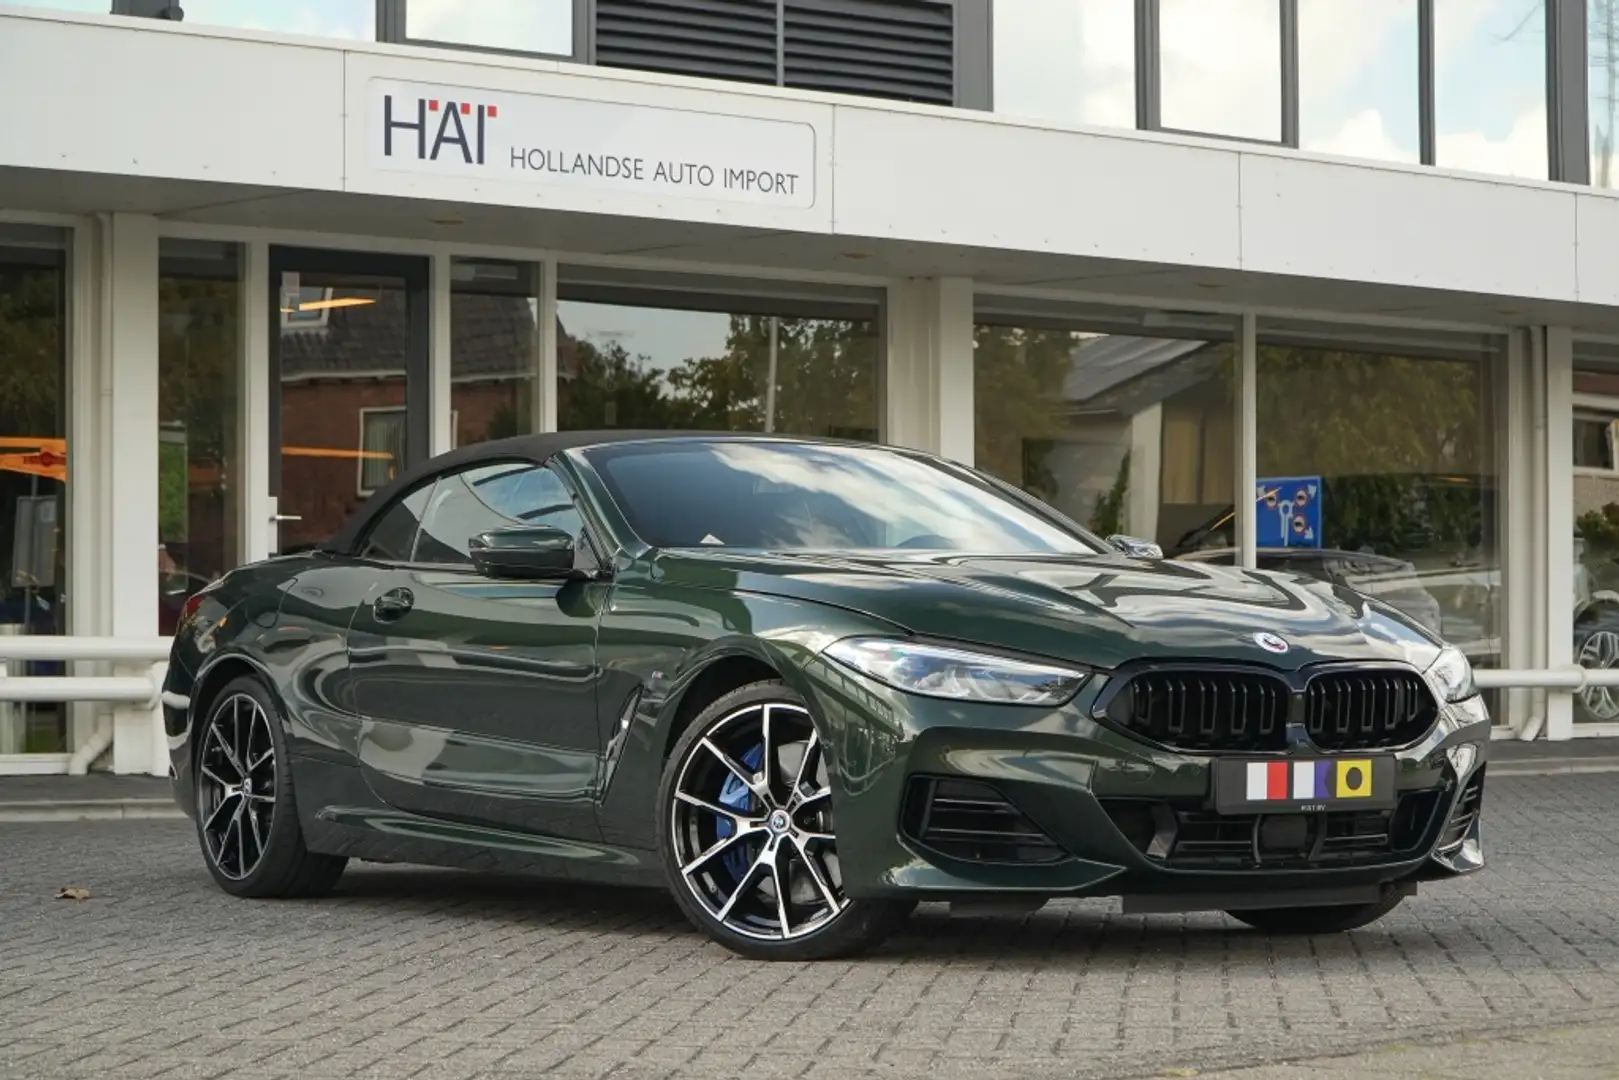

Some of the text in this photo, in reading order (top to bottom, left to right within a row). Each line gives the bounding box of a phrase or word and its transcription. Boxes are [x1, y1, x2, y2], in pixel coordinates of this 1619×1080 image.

[510, 147, 799, 195] HOLLANDSE AUTO IMPORT
